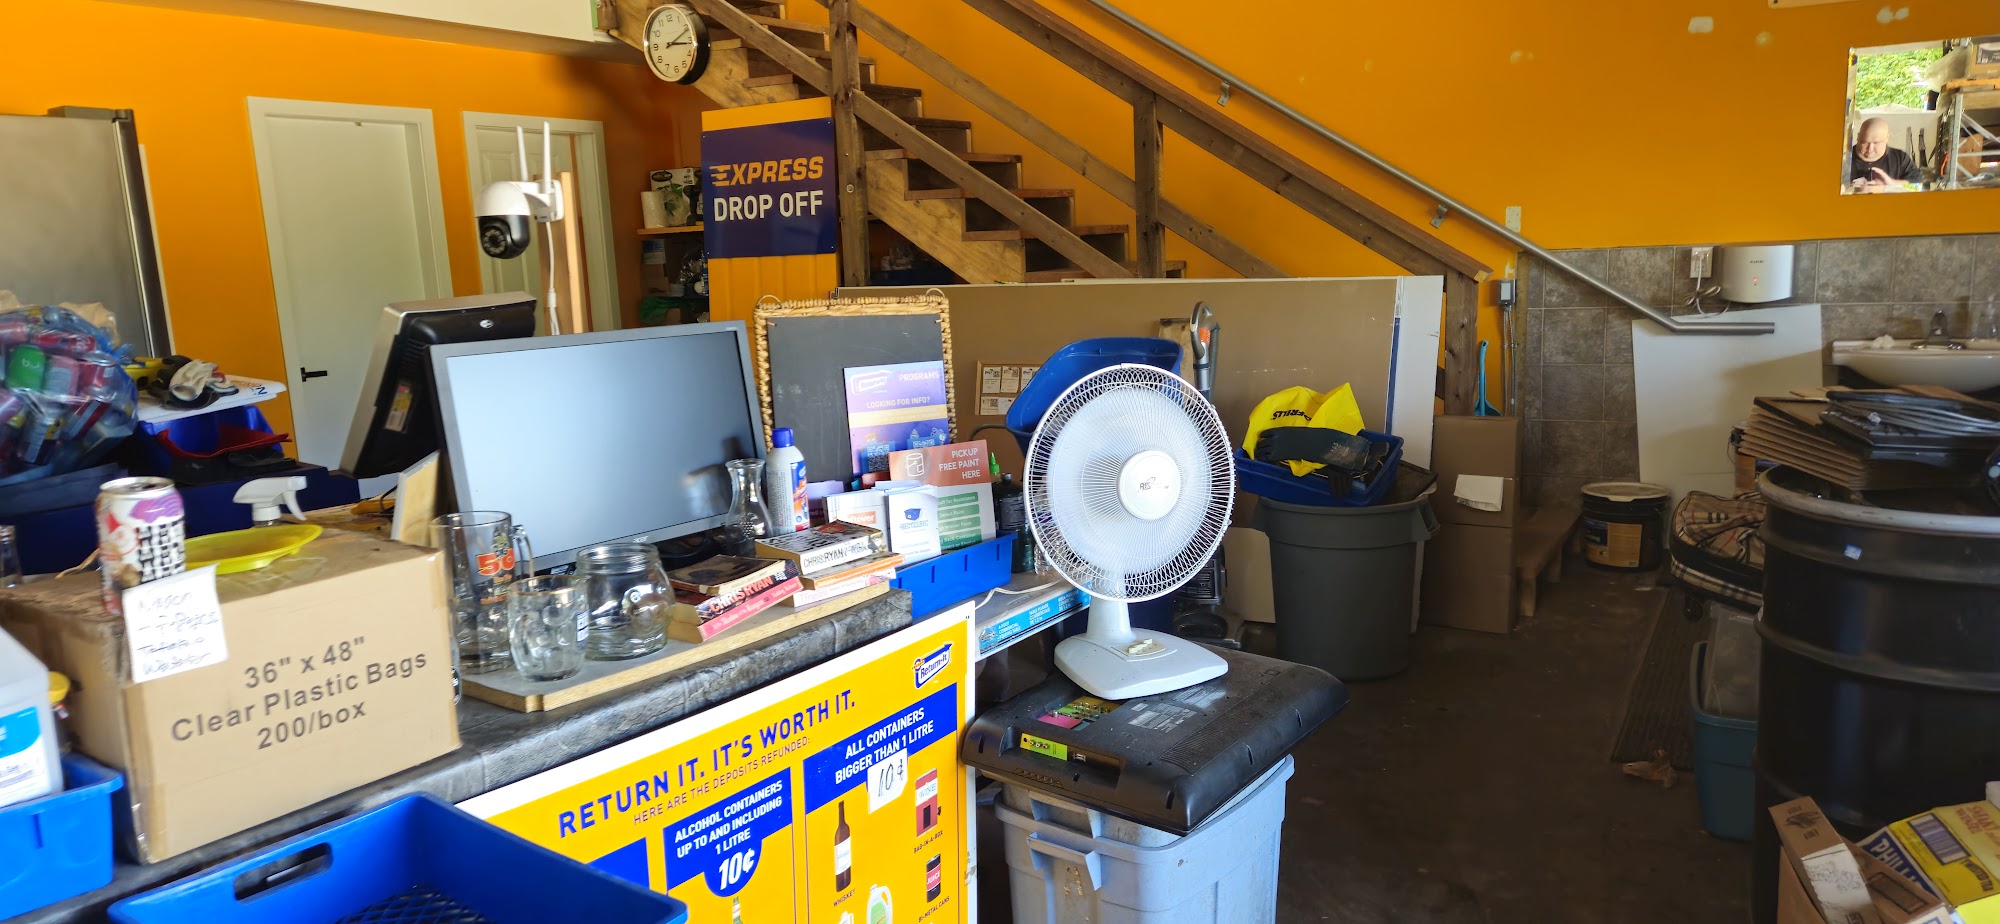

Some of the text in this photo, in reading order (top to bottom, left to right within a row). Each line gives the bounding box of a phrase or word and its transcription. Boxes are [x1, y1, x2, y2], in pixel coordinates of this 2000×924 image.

[666, 14, 673, 22] 12
[709, 156, 824, 186] EXPRESS
[714, 190, 823, 221] DROP OFF
[899, 371, 939, 381] PROGRAMS
[867, 400, 896, 408] LOOKING
[939, 459, 979, 472] FREE PAINT
[952, 448, 978, 458] PICKUP
[962, 470, 980, 479] HERE
[803, 549, 844, 568] CHRIS RYAN
[709, 586, 746, 613] CHRIS
[746, 576, 774, 596] RYAN
[244, 657, 291, 689] 36"
[300, 656, 316, 674] x
[322, 636, 365, 665] 48"
[921, 654, 947, 679] Return-It
[171, 652, 427, 741] Clear Plastic Bags
[257, 701, 367, 750] 200/box
[845, 707, 924, 760] ALL CONTAINERS
[558, 689, 855, 838] RETURN IT. IT'S WORTH IT.
[835, 720, 933, 784] BIGGER THAN 1 LITRE
[634, 737, 810, 826] HERE ARE THE DEPOSITS REFUNDED:
[675, 780, 782, 843] ALCOHOL CONTAINERS
[677, 796, 782, 858] UP TO AND INCLUDING
[715, 828, 751, 855] 1 LITRE
[913, 831, 943, 854] BAG-IN-A-BOX
[719, 848, 755, 890] 10¢
[927, 871, 940, 884] JUICE
[833, 889, 856, 907] WHISKEY
[918, 896, 950, 922] BI-METAL CANS
